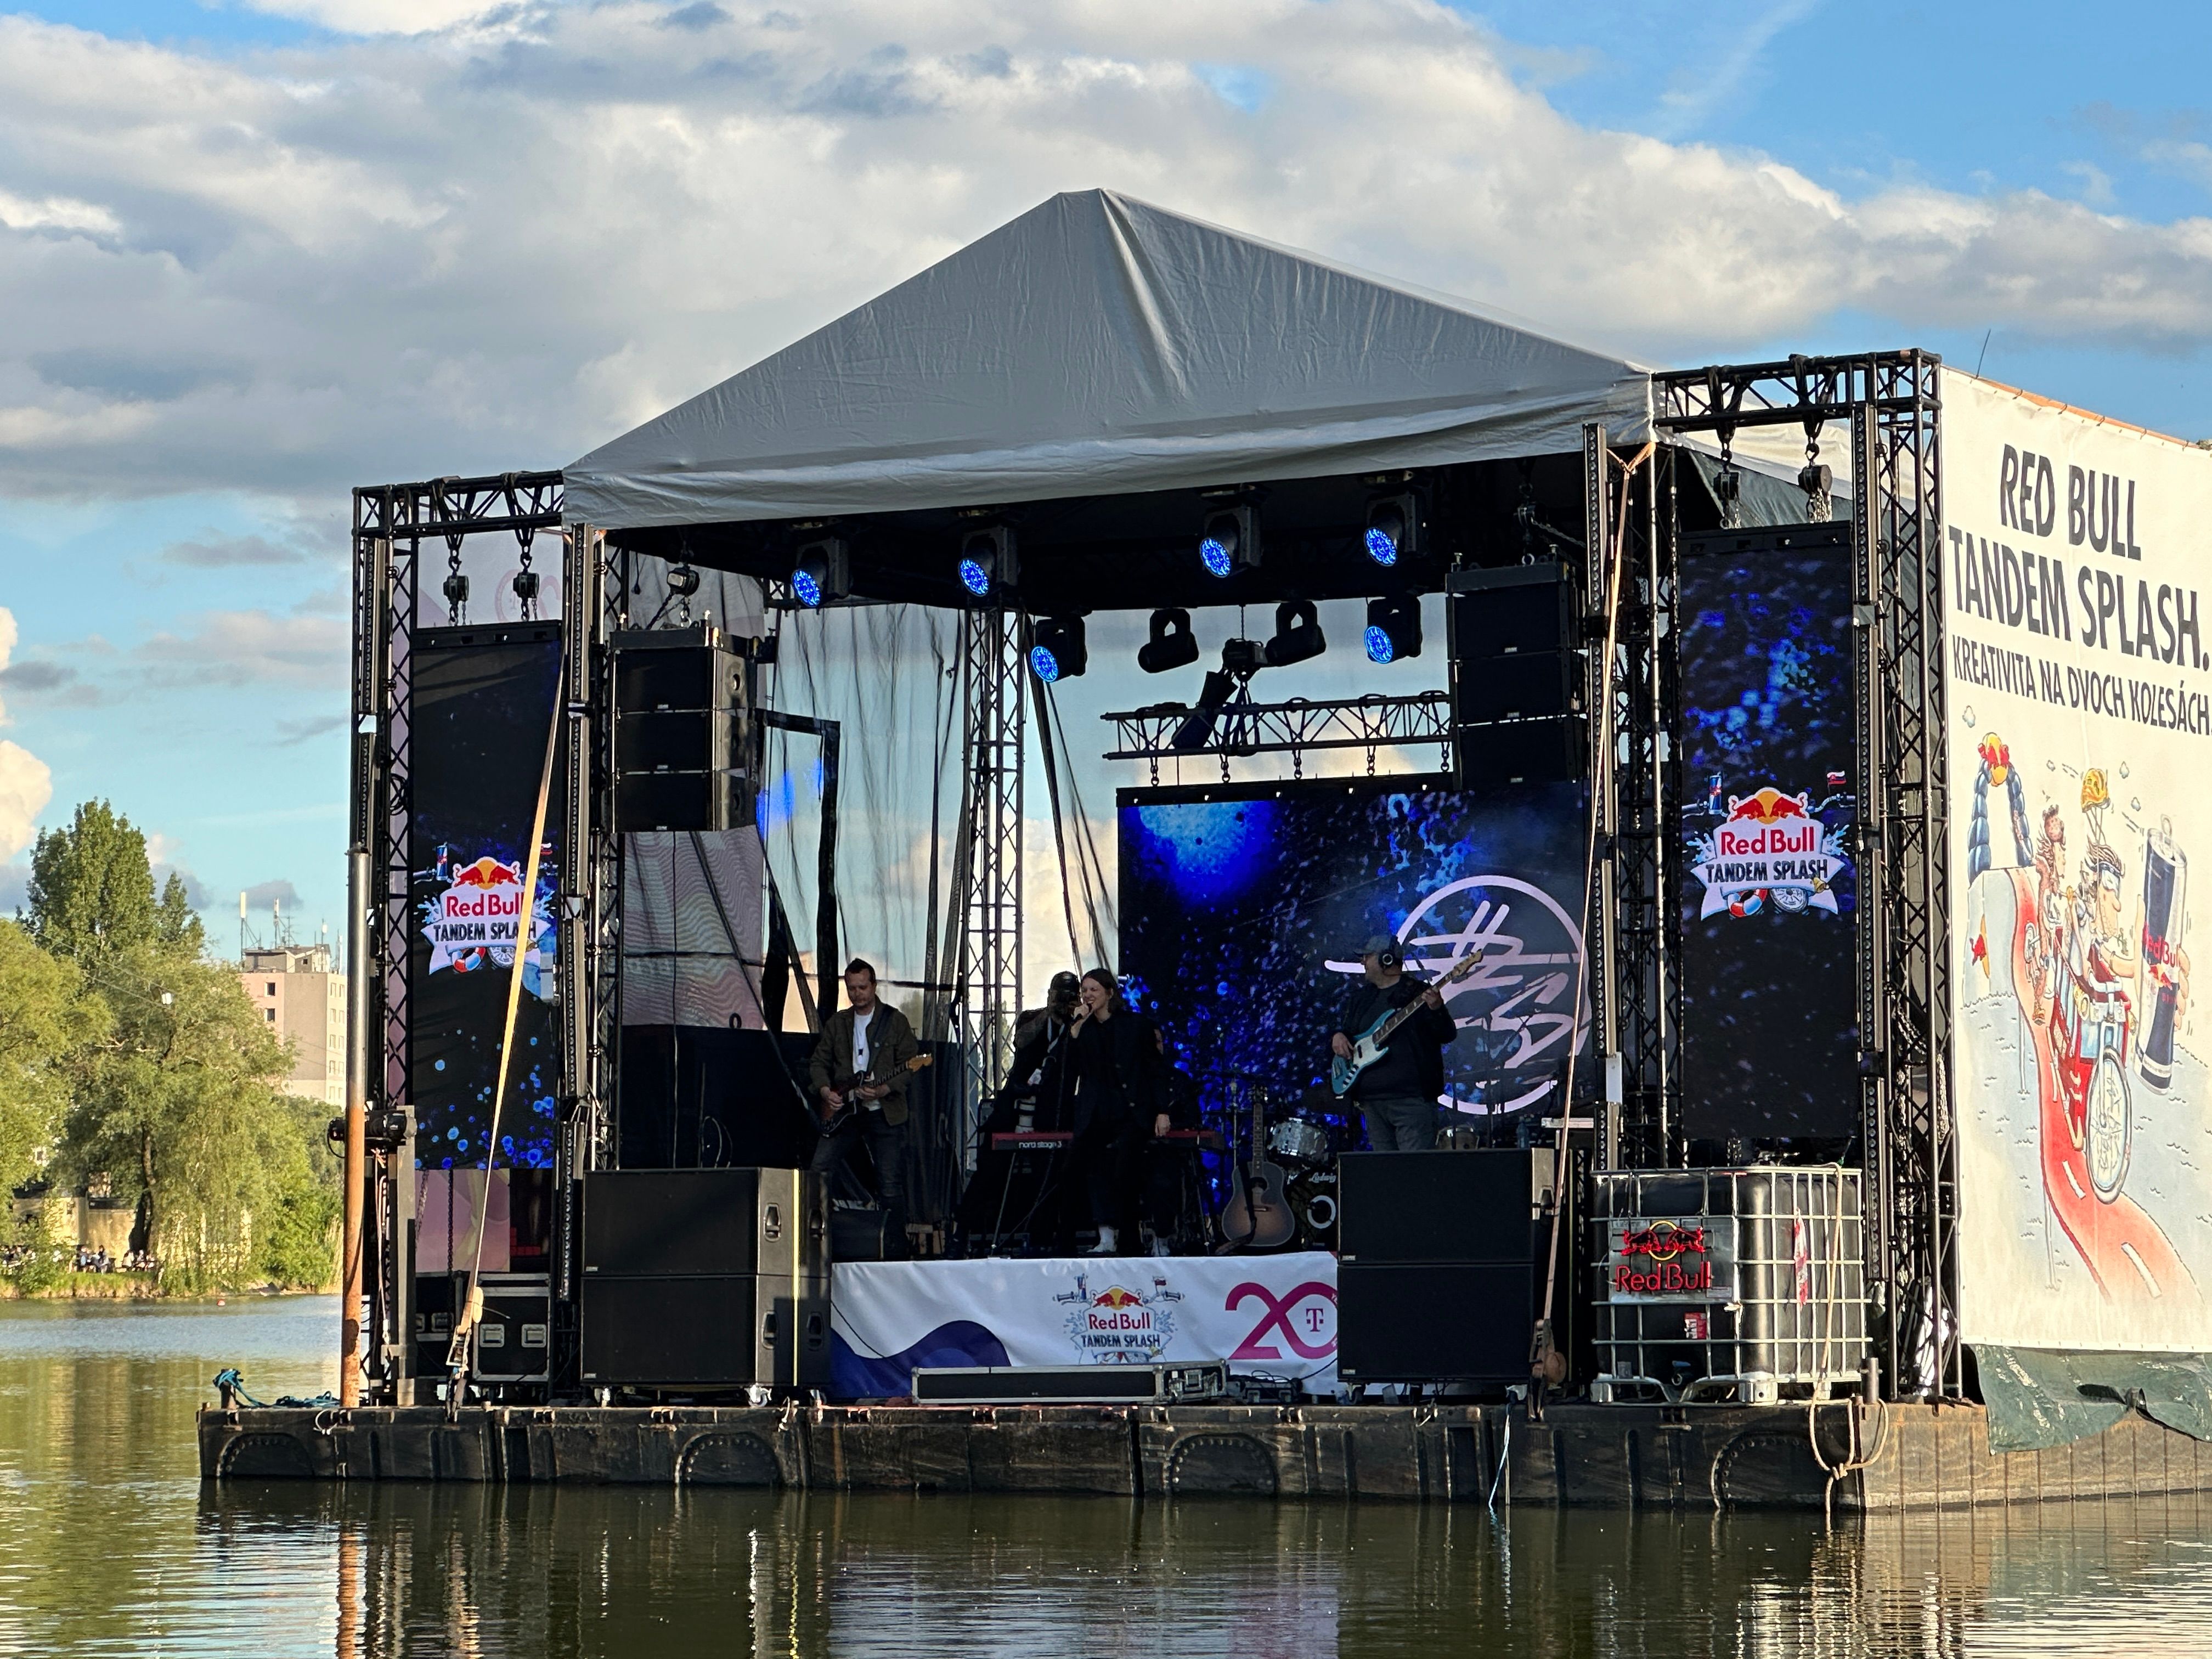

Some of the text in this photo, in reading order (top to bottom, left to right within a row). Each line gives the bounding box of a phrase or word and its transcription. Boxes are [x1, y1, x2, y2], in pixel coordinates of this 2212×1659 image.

[2000, 443, 2141, 561] RED BULL
[1948, 525, 2210, 672] TANDEM SPLASH.
[1952, 634, 2212, 736] KREATIVITA NA DVOCH KOLESÁCH
[1720, 826, 1814, 856] Red Bull
[1705, 859, 1829, 883] TANDEM SPLASH
[446, 894, 484, 917] Red
[433, 921, 537, 942] TANDEM SPLAH
[1308, 1172, 1336, 1183] Ludwig
[1615, 1260, 1712, 1292] Red Bull
[1088, 1312, 1150, 1330] Red Bull
[1225, 1281, 1338, 1360] 20
[1306, 1308, 1324, 1332] T
[1080, 1334, 1161, 1348] TANDEM SPLASH
